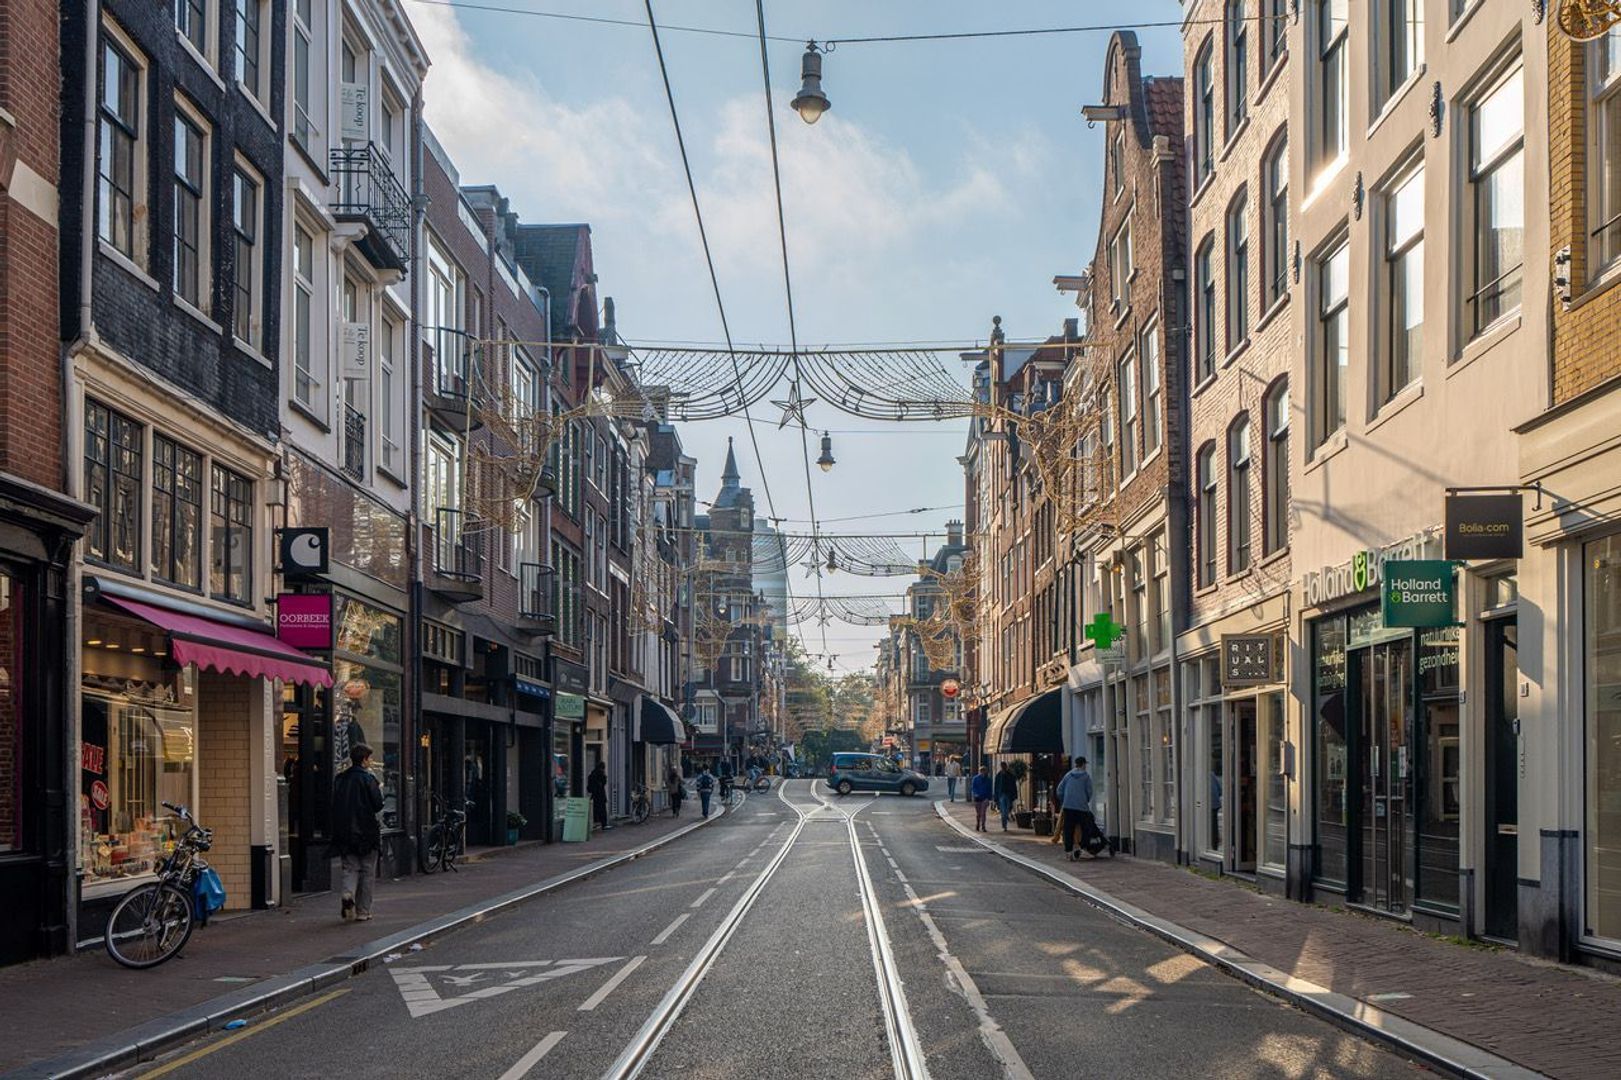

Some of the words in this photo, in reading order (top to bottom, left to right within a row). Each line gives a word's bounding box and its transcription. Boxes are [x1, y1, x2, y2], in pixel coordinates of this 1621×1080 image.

[356, 87, 366, 99] Te
[353, 102, 366, 127] koop
[357, 326, 368, 339] Te
[355, 341, 368, 366] koop
[1302, 556, 1354, 608] Holland
[1391, 579, 1441, 591] Holland
[1402, 591, 1448, 603] Barrett
[280, 613, 330, 623] OORBEEK
